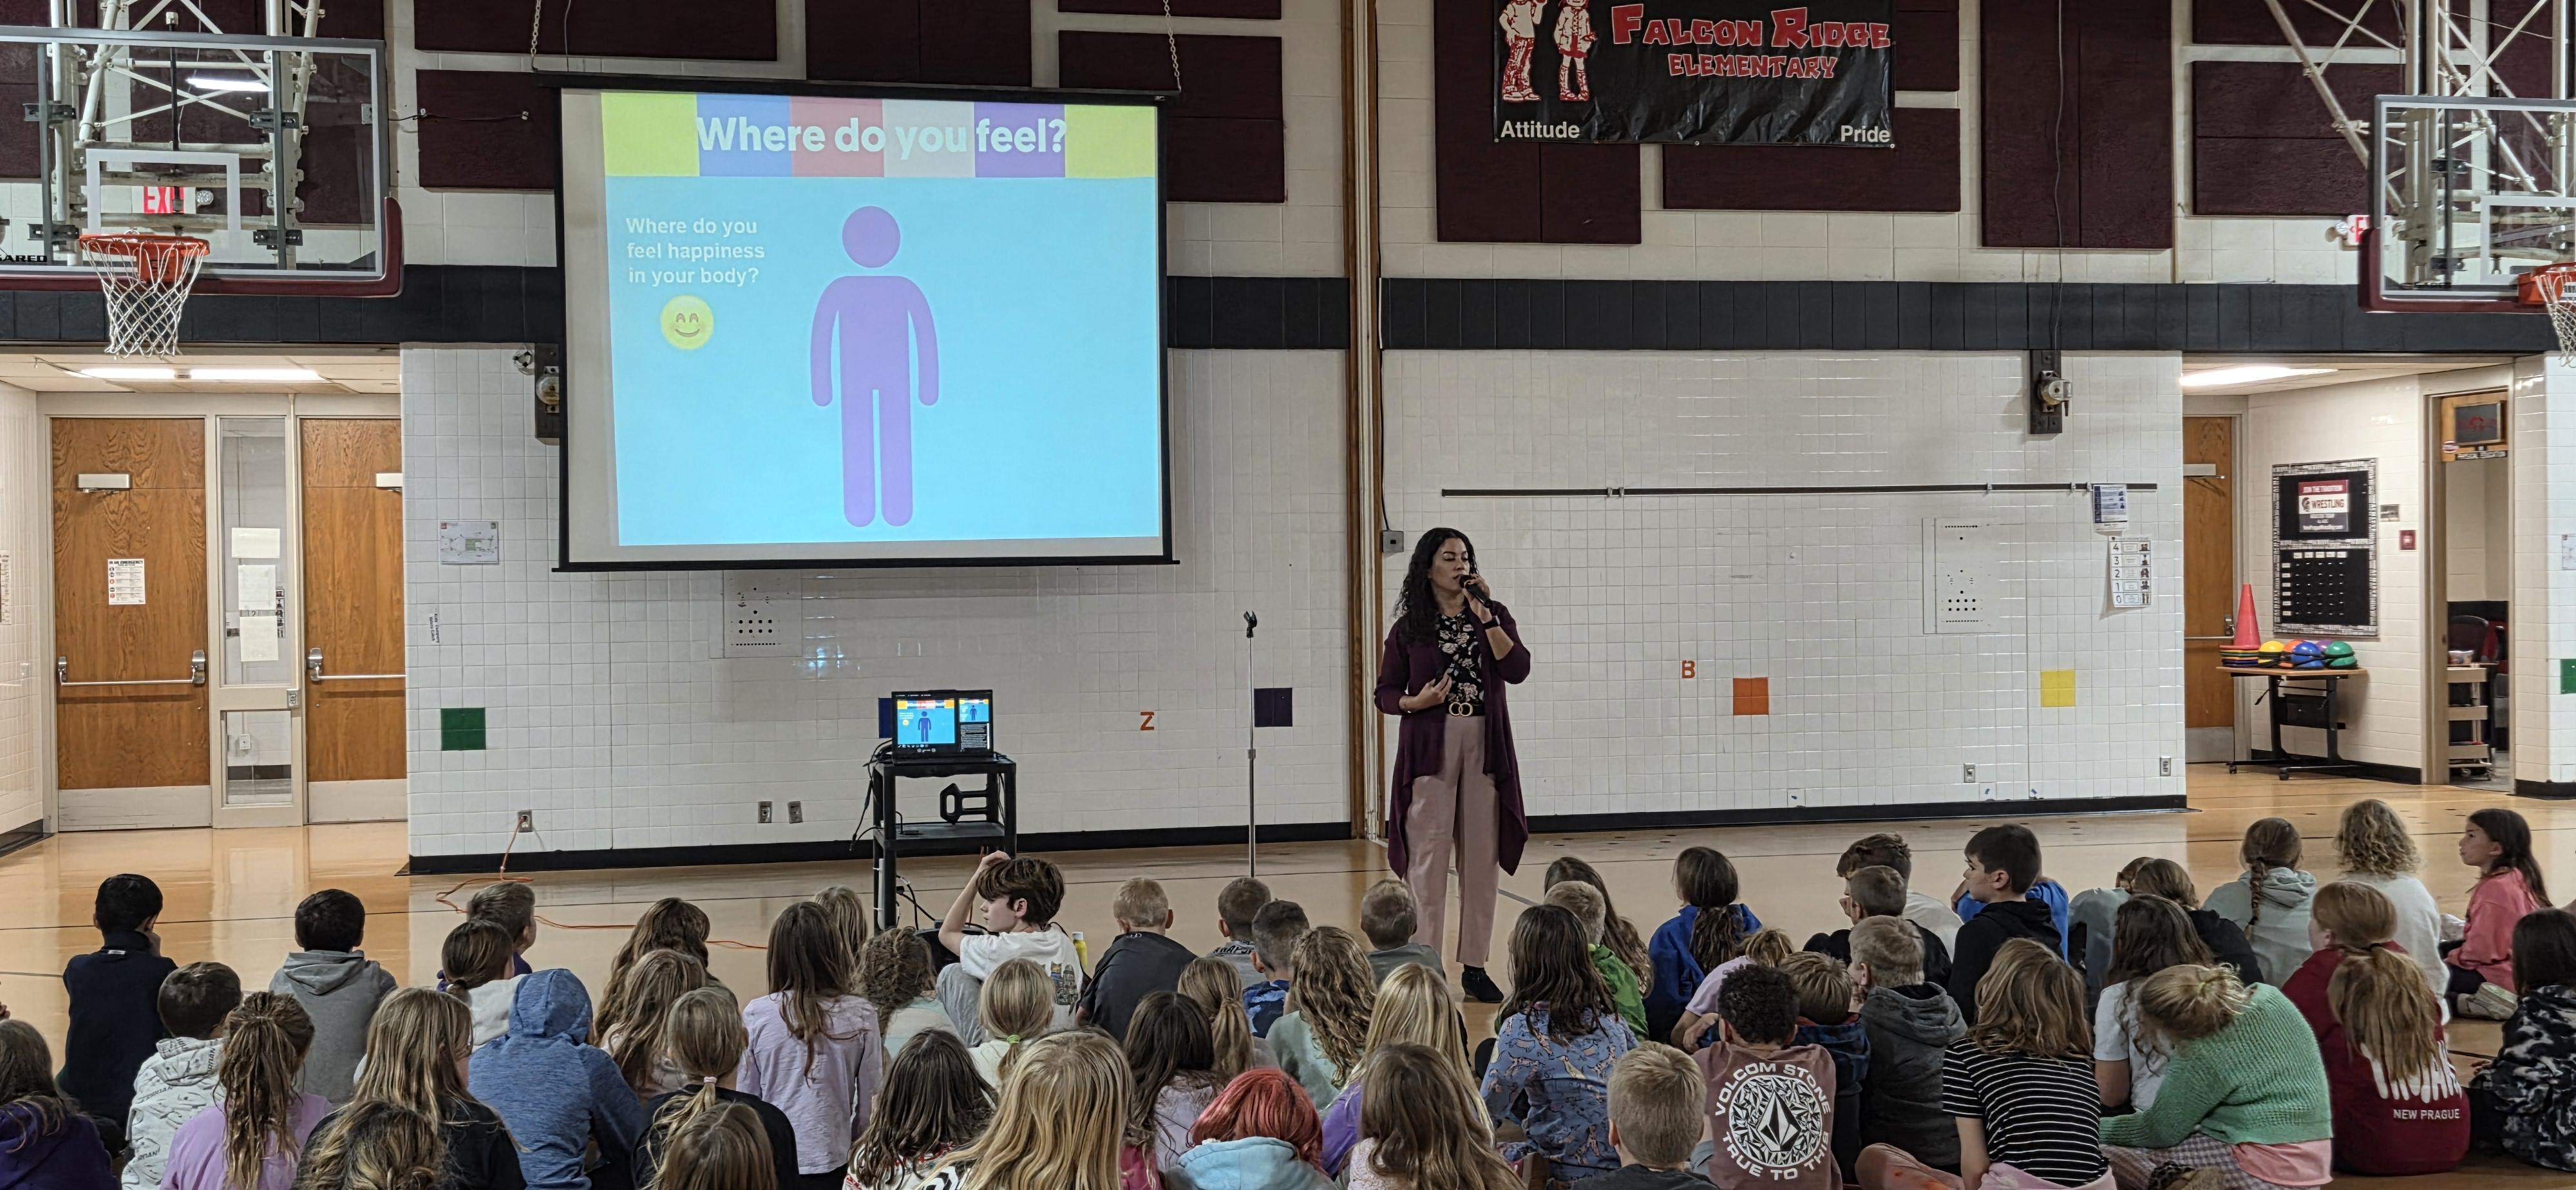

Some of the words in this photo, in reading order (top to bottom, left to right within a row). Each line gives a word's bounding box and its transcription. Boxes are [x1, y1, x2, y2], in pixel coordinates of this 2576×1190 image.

[1669, 53, 1837, 79] ELEMENTARY
[695, 117, 826, 152] Where
[835, 117, 886, 153] do
[895, 126, 966, 160] you
[976, 118, 1067, 153] feel?
[1501, 120, 1580, 138] Attitude
[1841, 125, 1891, 143] Pride
[625, 218, 687, 234] Where
[693, 218, 717, 234] do
[722, 221, 757, 238] you
[627, 242, 661, 259] feel
[668, 242, 765, 262] happiness
[629, 267, 646, 283] in
[652, 271, 696, 287] your
[701, 267, 759, 287] body?
[2311, 499, 2345, 509] WRESTLING
[2114, 556, 2119, 565] 3
[2115, 569, 2120, 578] 2
[2115, 582, 2120, 591] 1
[2116, 595, 2122, 603] 0
[1681, 659, 1696, 679] B
[1140, 711, 1155, 731] Z
[1715, 1062, 1776, 1116] VOLCOM
[1783, 1064, 1831, 1115] STONE
[2393, 1108, 2418, 1119] NEW
[2420, 1108, 2461, 1120] PRAGUE
[1723, 1131, 1763, 1177] TRUE
[1770, 1168, 1798, 1180] TO
[1803, 1131, 1830, 1171] THIS
